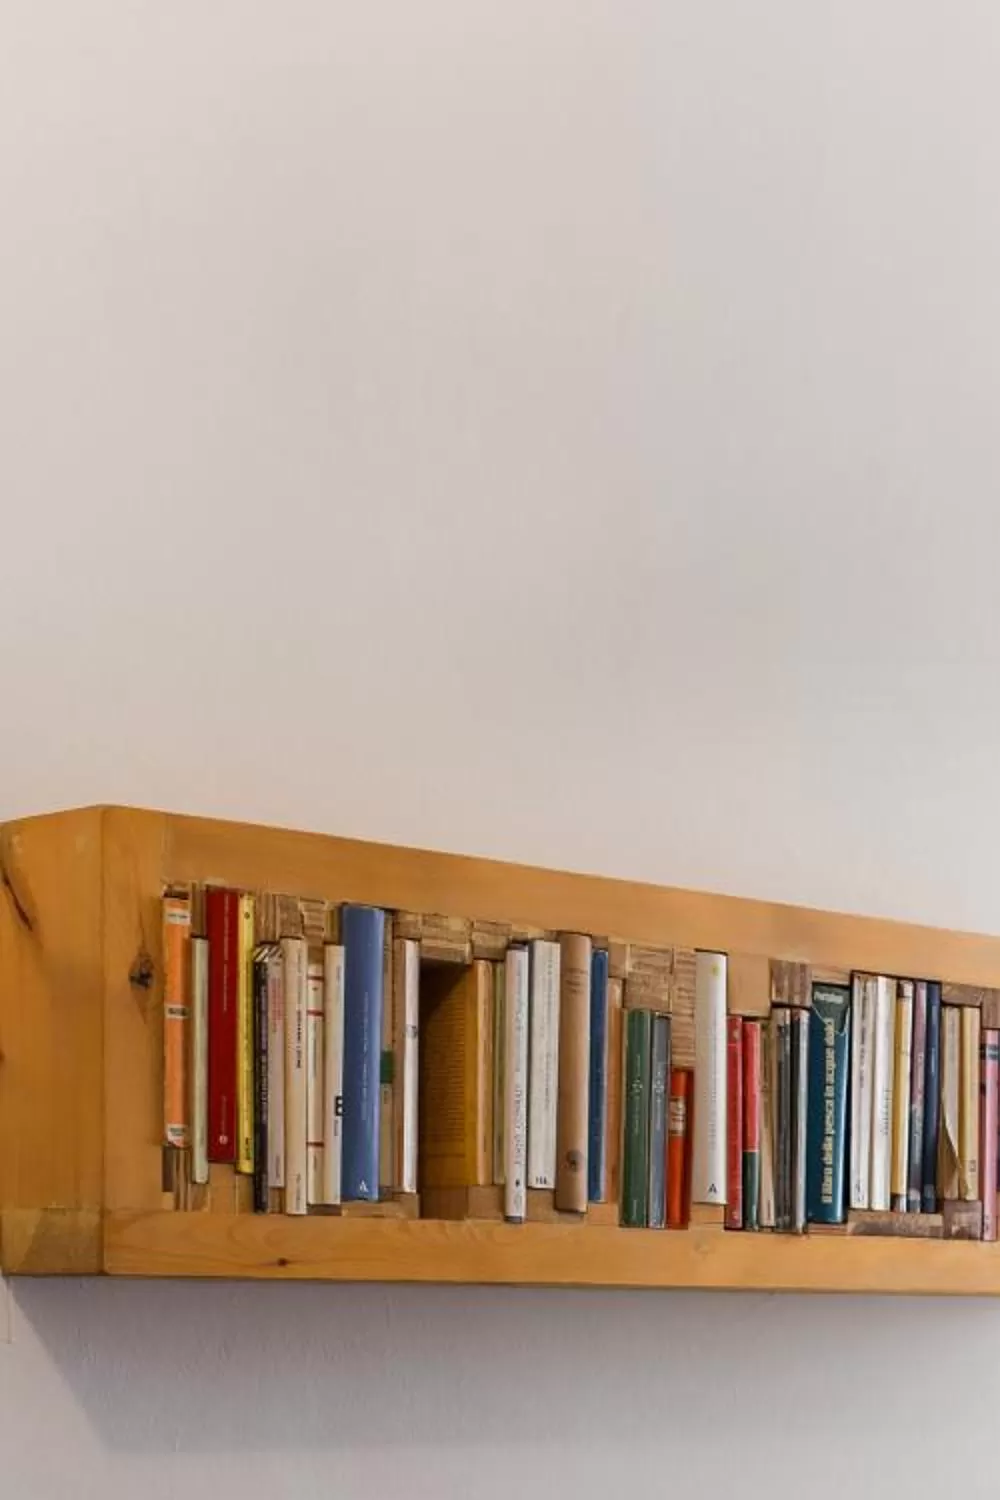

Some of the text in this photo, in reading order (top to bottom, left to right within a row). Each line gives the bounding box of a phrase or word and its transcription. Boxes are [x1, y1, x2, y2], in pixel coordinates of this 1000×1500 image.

[825, 1047, 836, 1084] acque
[824, 1086, 834, 1098] in
[824, 1099, 835, 1135] pesca
[821, 1136, 832, 1165] della
[821, 1167, 832, 1194] libro
